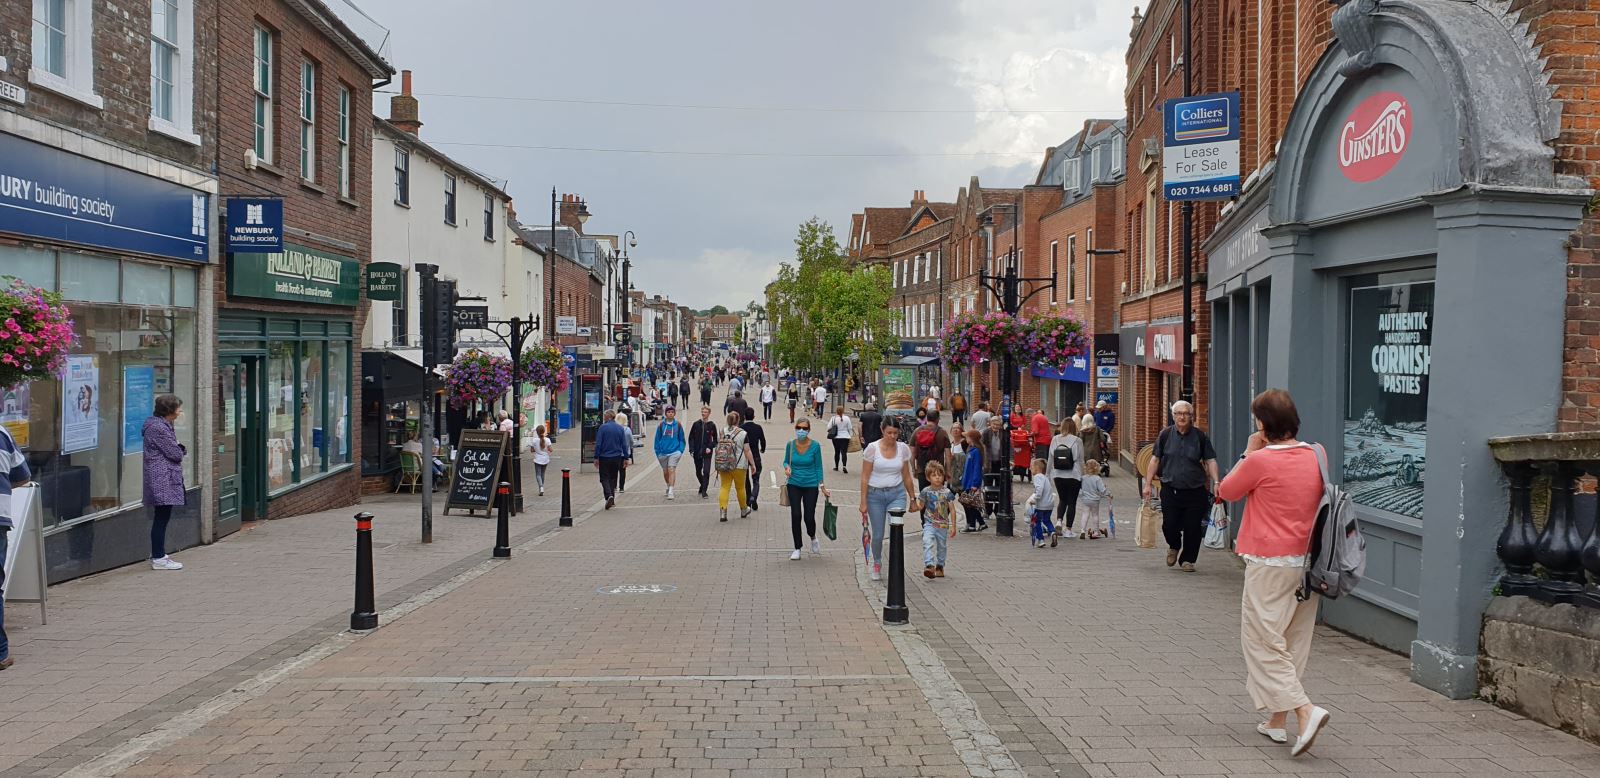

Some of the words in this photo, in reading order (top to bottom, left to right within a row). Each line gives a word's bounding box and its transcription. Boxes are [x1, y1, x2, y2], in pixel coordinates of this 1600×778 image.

[0, 81, 20, 100] REET
[1181, 107, 1223, 121] Colliers
[1184, 147, 1220, 159] Lease
[1176, 162, 1197, 174] For
[1201, 159, 1228, 172] Sale
[1170, 187, 1188, 197] 020
[1190, 186, 1211, 195] 7344
[1213, 183, 1233, 193] 6881
[0, 174, 31, 200] URY
[35, 181, 78, 215] building
[81, 197, 115, 223] society
[230, 235, 255, 243] building
[256, 235, 279, 243] society
[267, 248, 305, 275] HOLLAND
[370, 271, 397, 279] HOLLAND
[370, 284, 397, 292] BARRETT
[1379, 312, 1428, 331] AUTHENTIC
[1384, 332, 1420, 344] HANDCRIMPED
[1371, 345, 1432, 375] CORNISH
[1383, 375, 1421, 395] PASTIES
